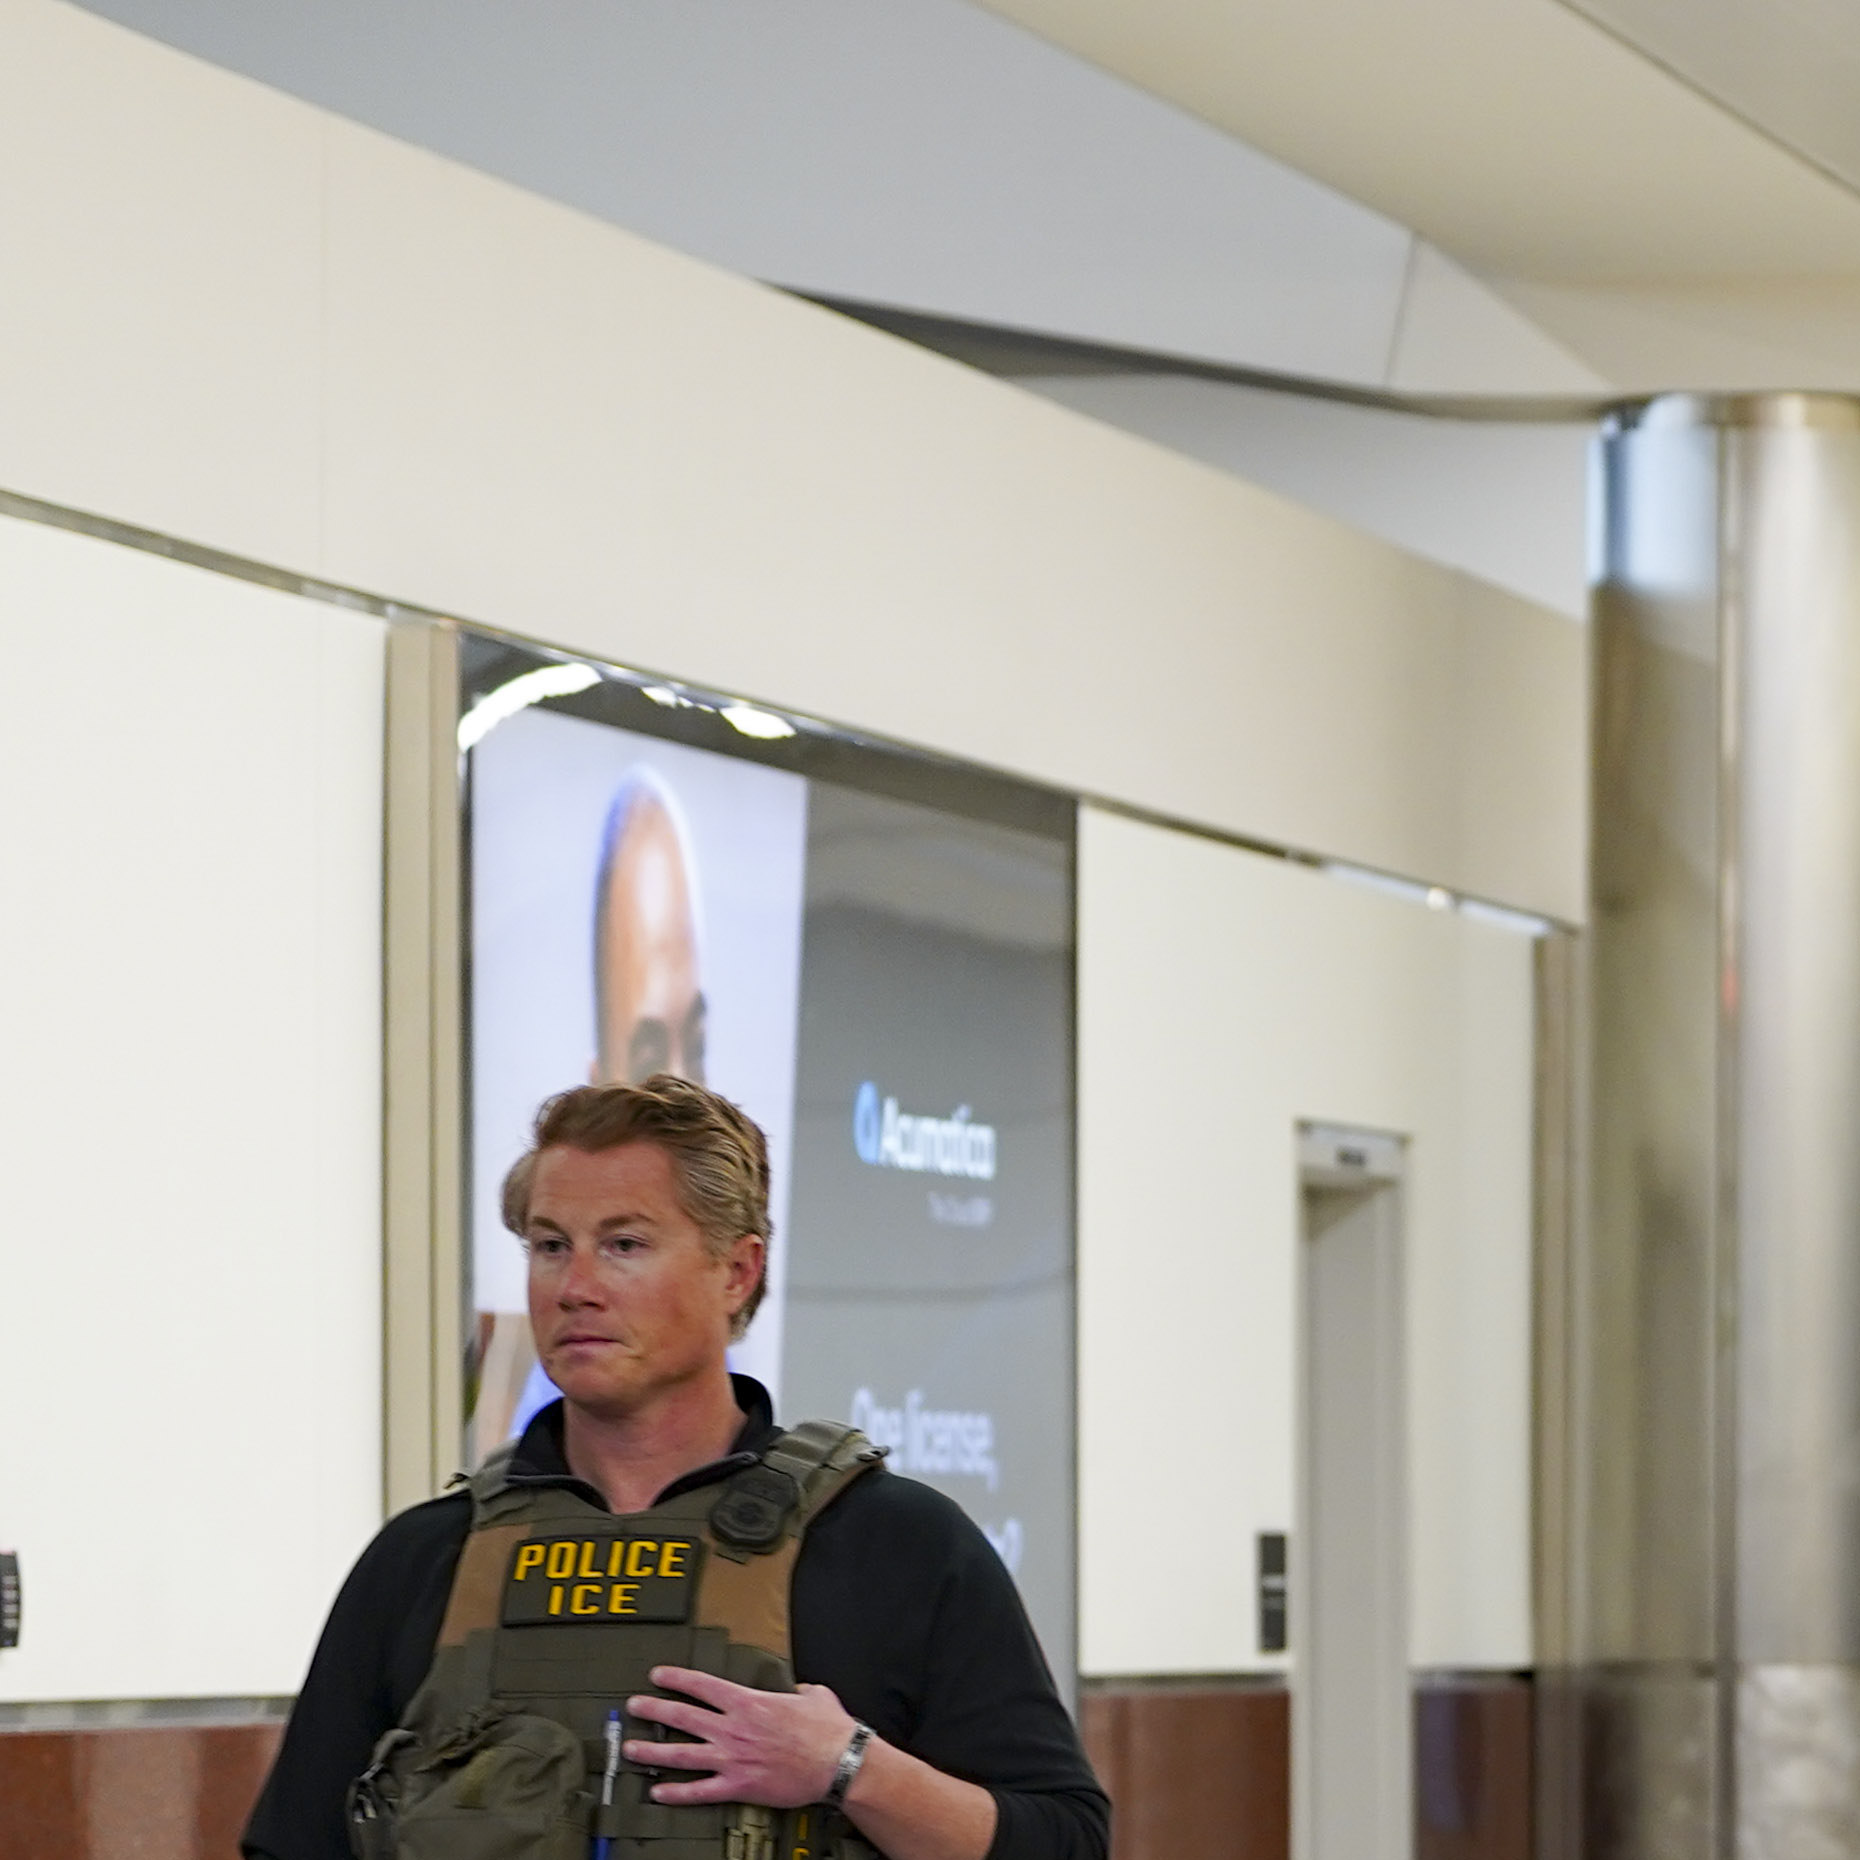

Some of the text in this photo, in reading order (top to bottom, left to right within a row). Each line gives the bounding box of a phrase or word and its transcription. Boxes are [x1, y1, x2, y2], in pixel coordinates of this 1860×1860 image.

[879, 1096, 996, 1181] Acumatica
[513, 1540, 692, 1581] POLICE
[547, 1583, 642, 1616] ICE
